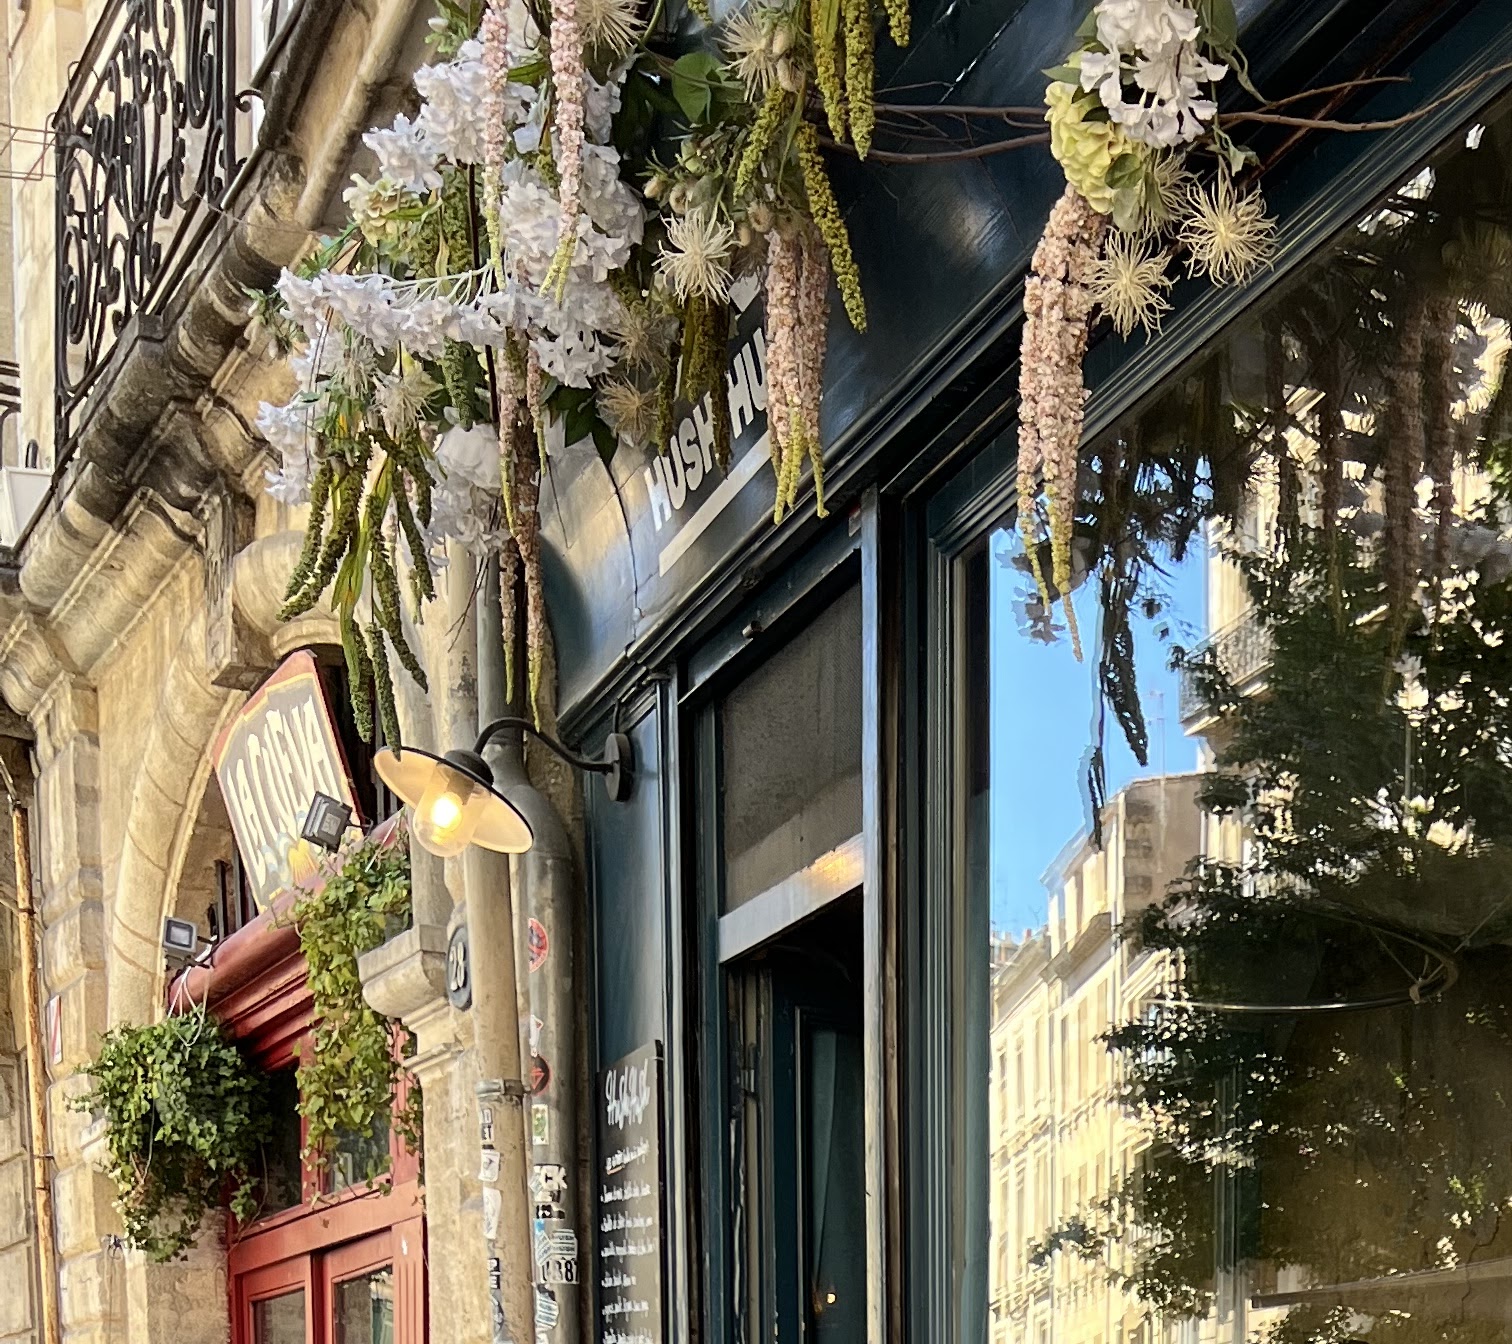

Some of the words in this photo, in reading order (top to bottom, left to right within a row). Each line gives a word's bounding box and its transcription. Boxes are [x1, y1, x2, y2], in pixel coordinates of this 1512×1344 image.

[644, 391, 717, 532] HUSH
[247, 694, 342, 846] CUEVA
[450, 942, 465, 991] 28
